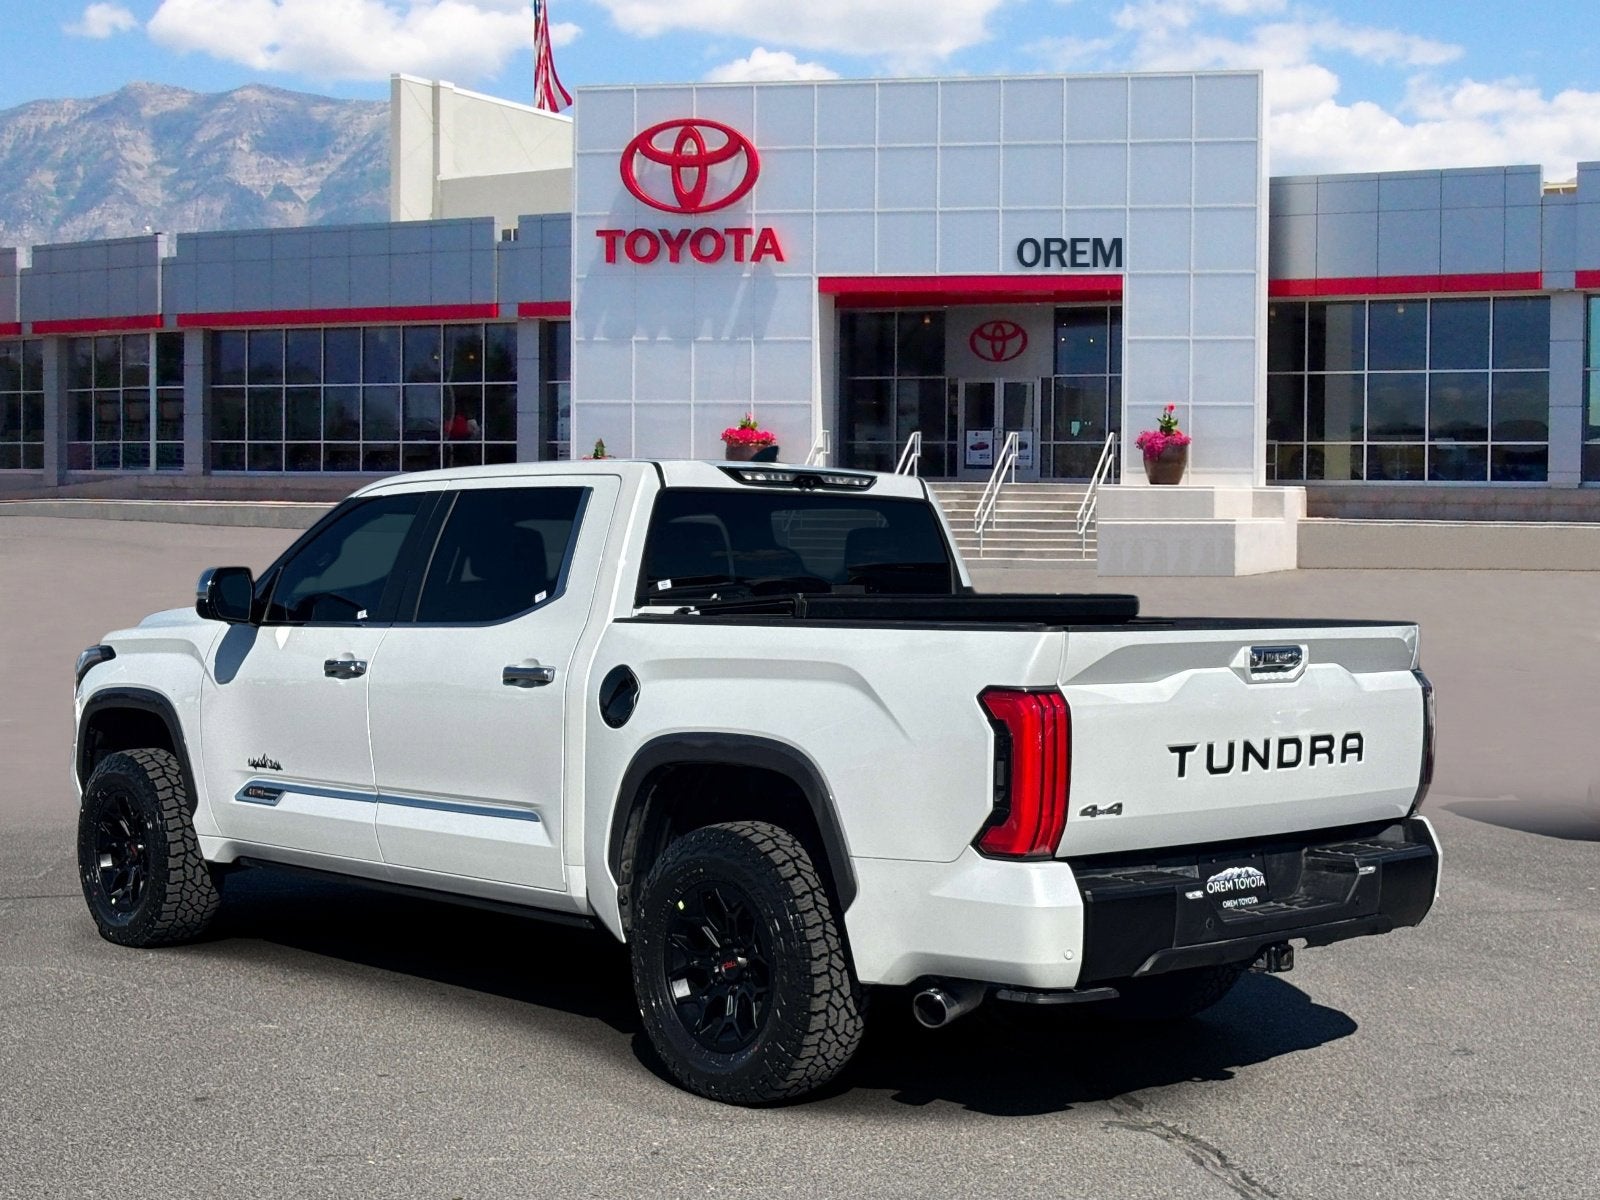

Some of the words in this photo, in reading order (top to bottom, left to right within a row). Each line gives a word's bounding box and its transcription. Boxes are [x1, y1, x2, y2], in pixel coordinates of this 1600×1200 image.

[596, 227, 784, 264] TOYOTA
[1017, 237, 1122, 268] OREM
[1167, 731, 1364, 778] TUNDRA
[1206, 880, 1233, 894] OREM
[1234, 875, 1266, 890] TOYOTA
[1222, 899, 1239, 908] OREM
[1239, 896, 1258, 906] TOYOTA
